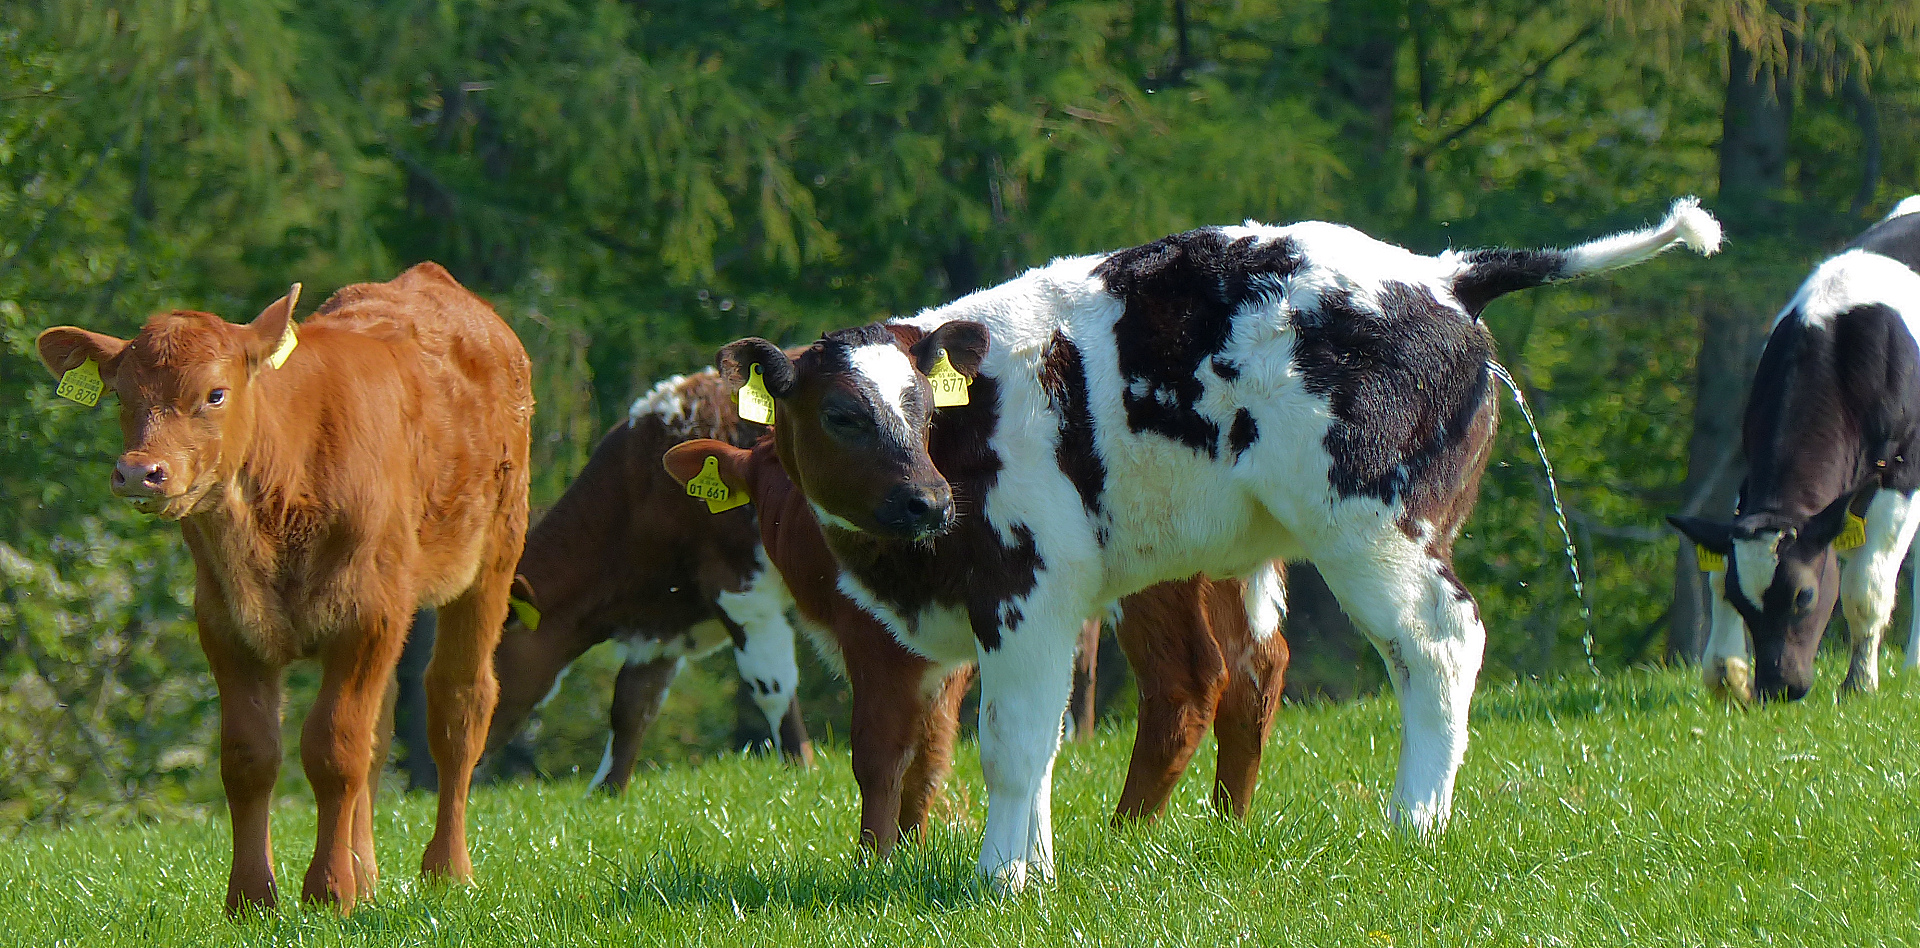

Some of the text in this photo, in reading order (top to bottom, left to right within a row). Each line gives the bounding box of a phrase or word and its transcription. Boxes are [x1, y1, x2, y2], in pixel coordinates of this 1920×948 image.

[58, 381, 97, 404] 39 879
[943, 377, 964, 392] 877
[690, 484, 725, 500] 01 661
